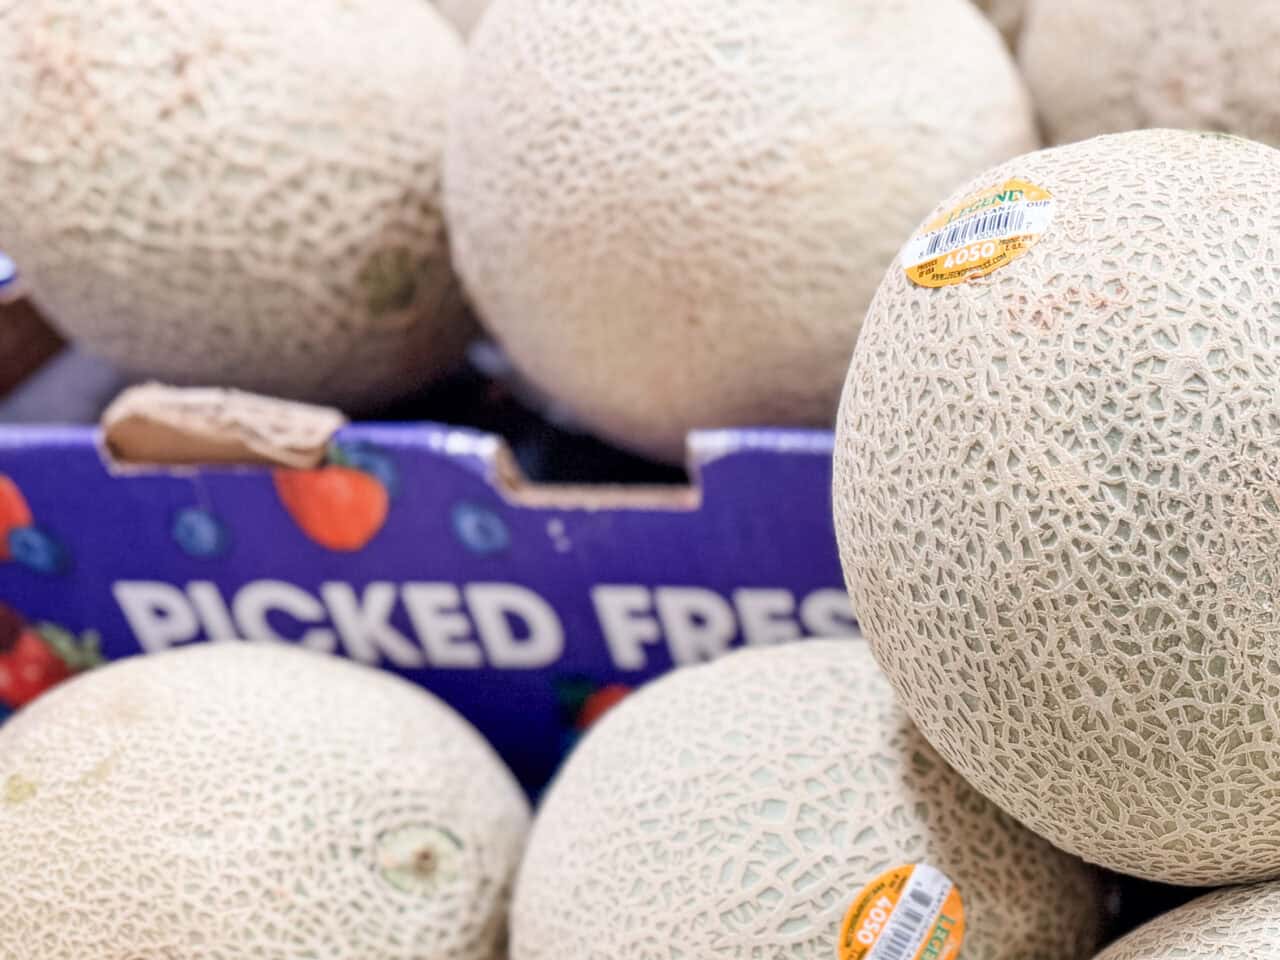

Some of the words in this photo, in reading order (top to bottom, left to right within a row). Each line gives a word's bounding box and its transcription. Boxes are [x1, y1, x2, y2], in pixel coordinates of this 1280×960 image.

[943, 241, 997, 269] 4050
[111, 579, 565, 669] PICKED
[856, 896, 893, 945] 4050
